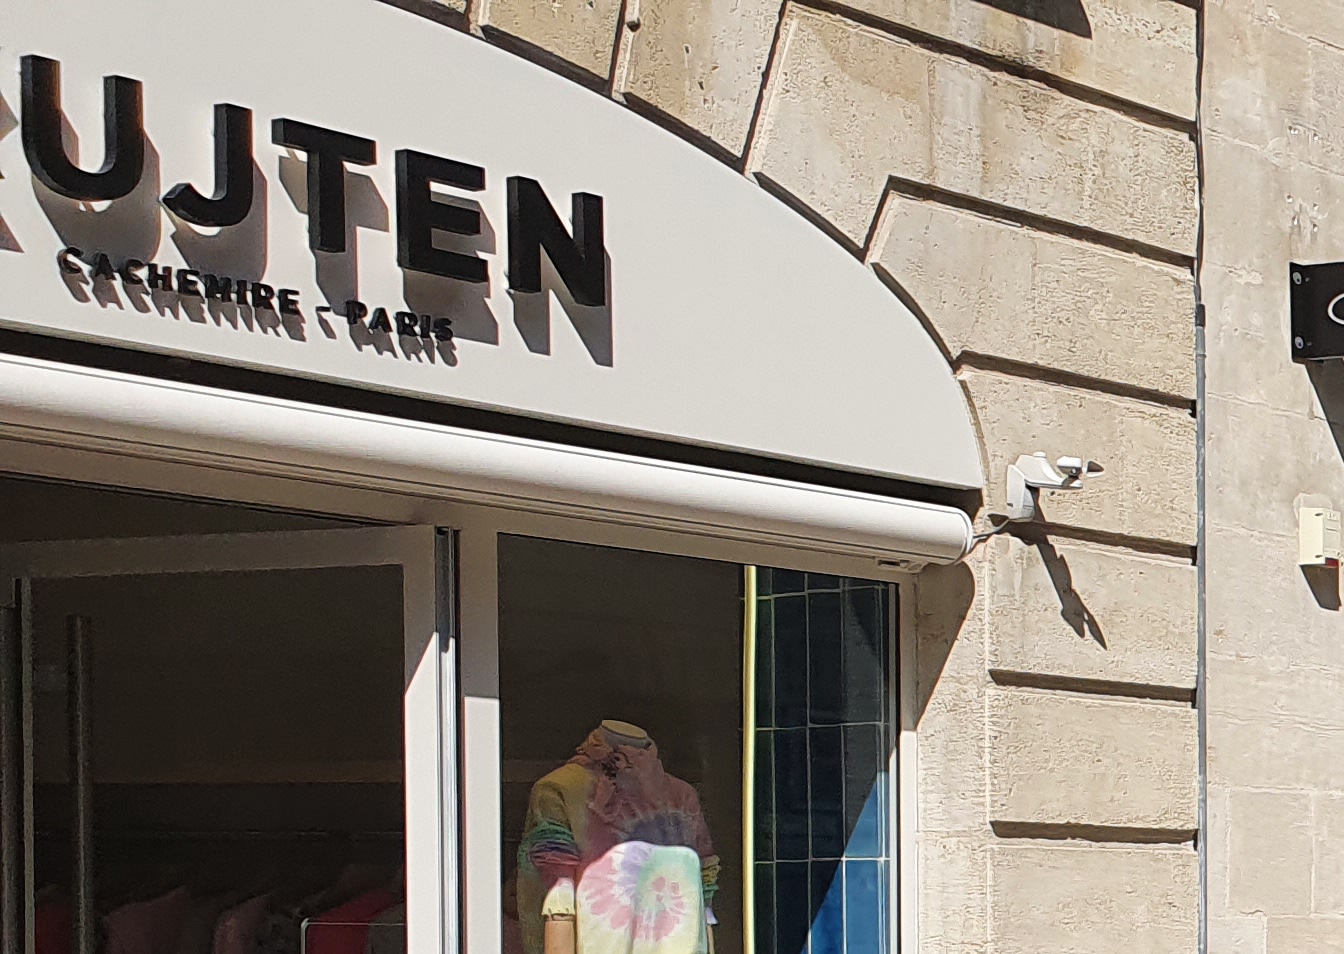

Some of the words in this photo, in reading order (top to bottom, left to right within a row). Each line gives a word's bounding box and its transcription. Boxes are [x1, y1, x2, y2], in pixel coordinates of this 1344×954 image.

[19, 54, 607, 307] UJTEN
[57, 246, 301, 317] CACHEMIRE
[345, 300, 455, 342] PARIS
